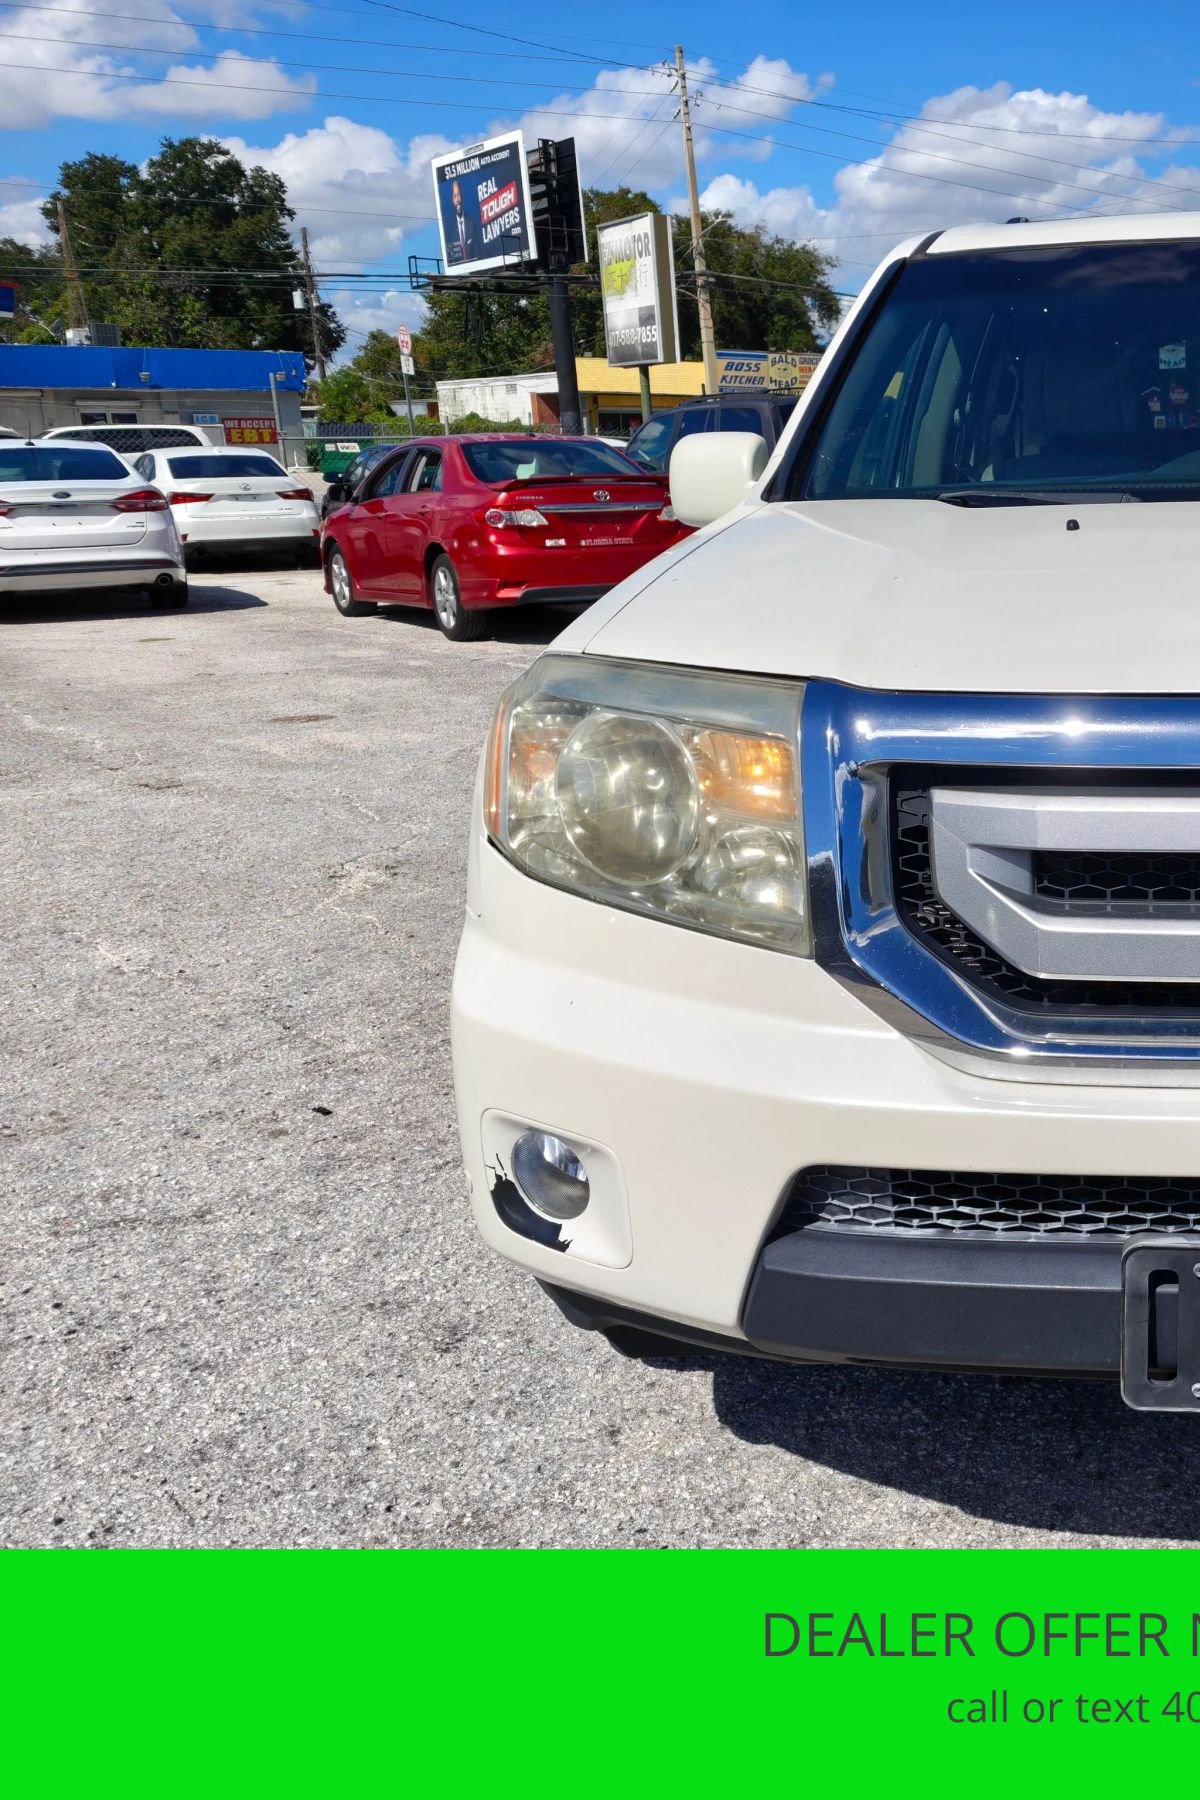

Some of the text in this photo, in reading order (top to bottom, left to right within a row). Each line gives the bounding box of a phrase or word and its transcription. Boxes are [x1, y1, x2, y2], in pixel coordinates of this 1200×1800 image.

[456, 156, 480, 176] MILLION
[491, 149, 510, 162] ACCIDENT
[477, 176, 498, 202] REAL
[482, 187, 514, 220] TOUGH
[482, 206, 520, 244] LAWYERS
[724, 361, 761, 372] BOSS
[770, 354, 798, 369] BALD
[720, 375, 765, 385] KITCHEN
[769, 376, 798, 389] HEAD
[224, 419, 275, 428] WE ACCEPT
[230, 428, 272, 442] EBT
[585, 538, 613, 547] FLORIDA
